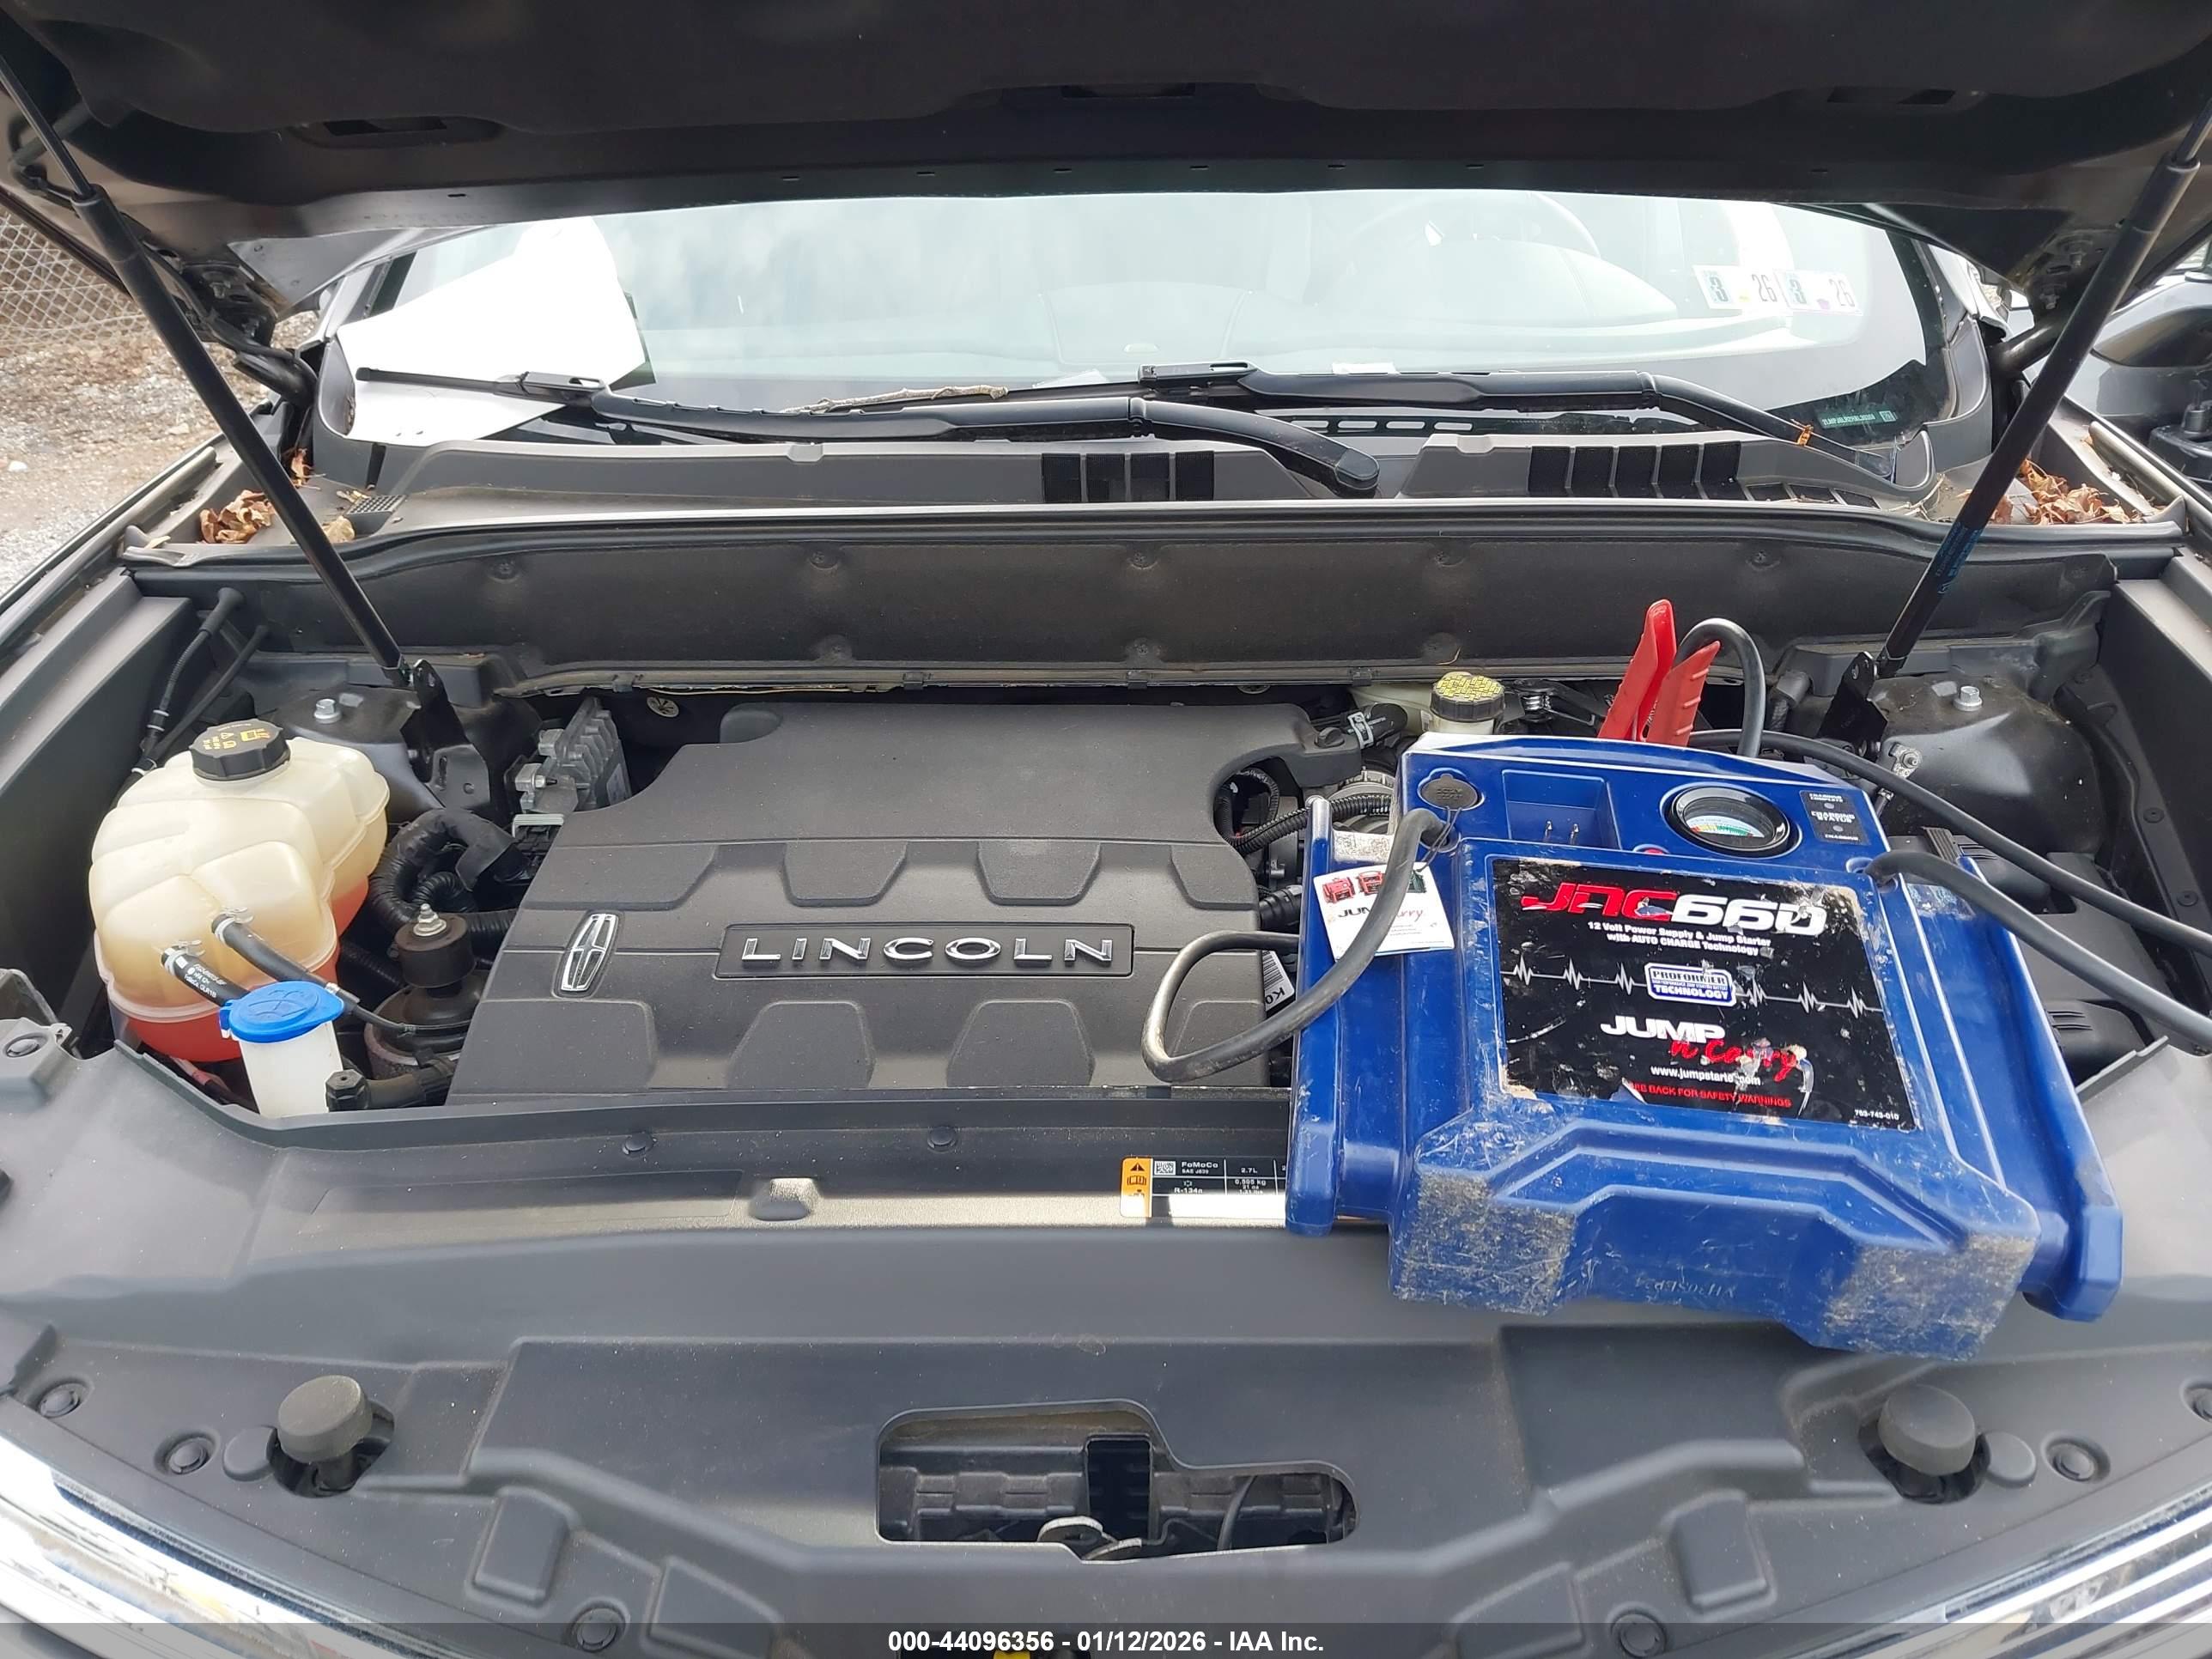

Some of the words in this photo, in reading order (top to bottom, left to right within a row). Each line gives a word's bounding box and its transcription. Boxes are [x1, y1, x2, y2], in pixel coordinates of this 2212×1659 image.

[1588, 921, 1601, 930] 12
[1602, 923, 1623, 933] Volt
[1625, 925, 1656, 936] Power
[1658, 928, 1694, 941] Supply
[1706, 933, 1735, 945] Jump
[1736, 936, 1771, 947] Starter
[1607, 933, 1631, 942] with
[1632, 936, 1658, 945] AUTO
[1660, 939, 1701, 950] CHARGE
[1702, 941, 1759, 957] Technology
[741, 937, 1113, 962] LINCOLN
[1654, 984, 1729, 1000] TECHNOLOGY
[1600, 1014, 1726, 1045] JUMP
[1648, 1085, 1676, 1097] BACK
[1678, 1088, 1698, 1098] FOR
[1699, 1091, 1735, 1103] SAFETY
[1739, 1094, 1792, 1109] WARNINGS
